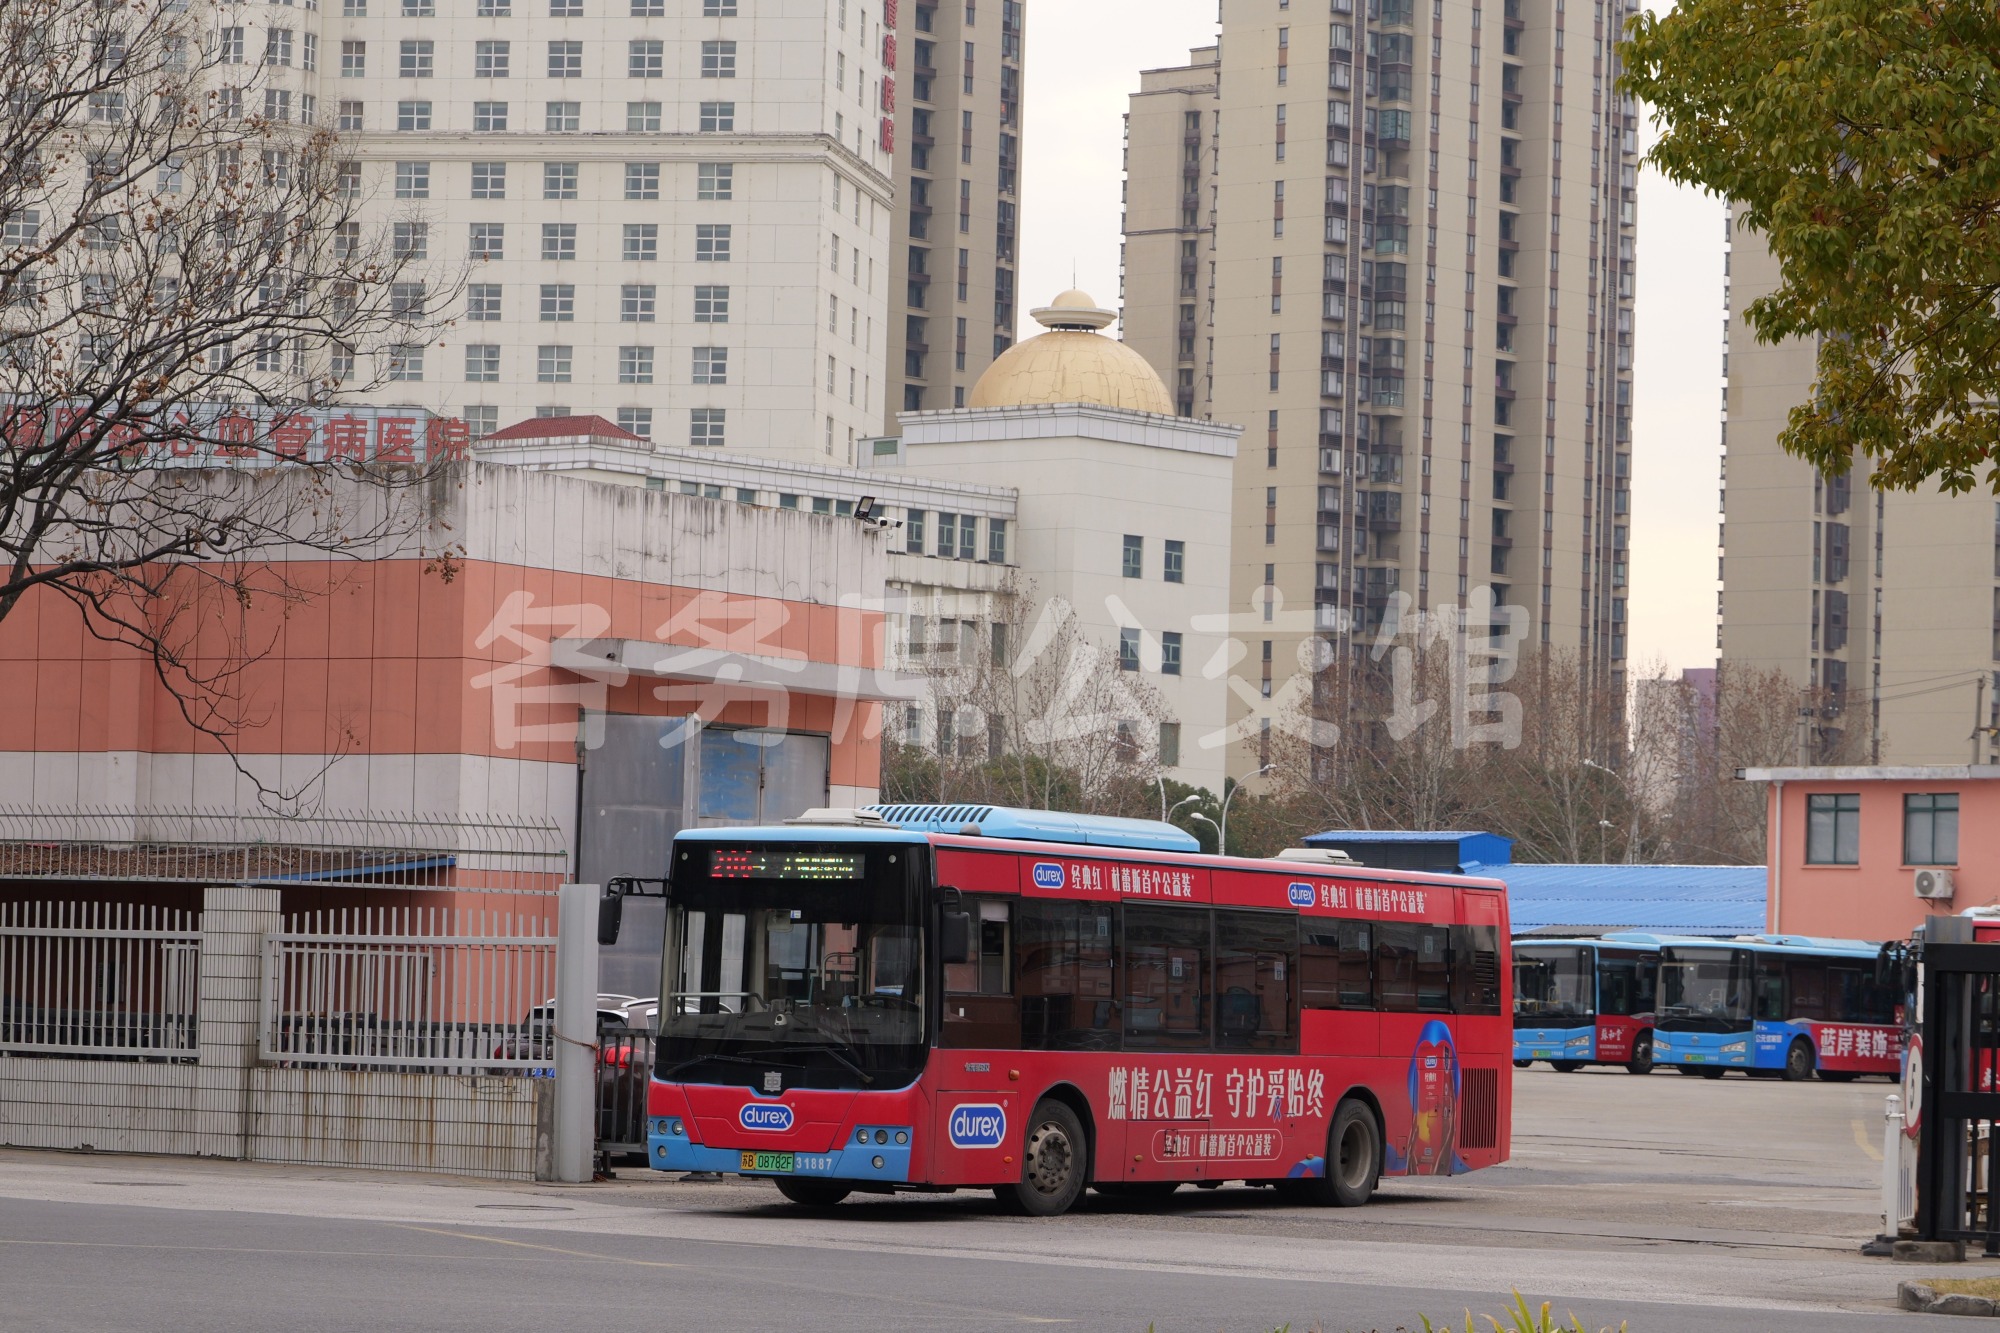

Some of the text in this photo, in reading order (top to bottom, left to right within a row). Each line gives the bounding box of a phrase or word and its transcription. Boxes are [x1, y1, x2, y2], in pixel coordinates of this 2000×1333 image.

[1036, 867, 1063, 884] durex
[1071, 864, 1102, 890] 经典红
[1290, 887, 1314, 904] durex
[1320, 884, 1348, 909] 经典红
[1820, 1027, 1888, 1058] 蓝岸装饰
[1108, 1066, 1325, 1120] 燃情公益红 守护爱始终
[744, 1107, 790, 1127] durex
[954, 1110, 1002, 1141] durex
[1163, 1135, 1191, 1157] 经典红
[796, 1157, 833, 1170] 31887
